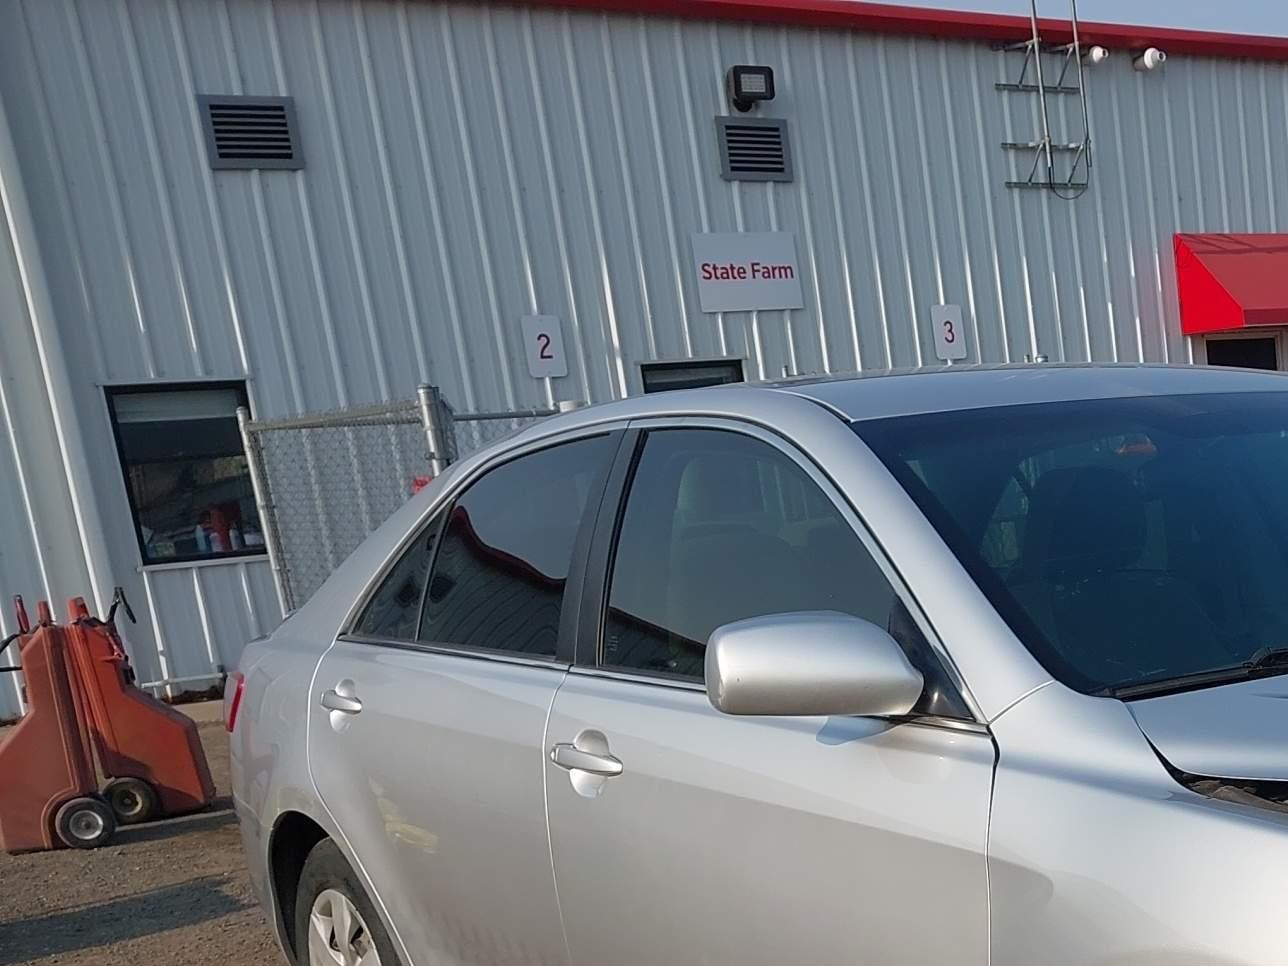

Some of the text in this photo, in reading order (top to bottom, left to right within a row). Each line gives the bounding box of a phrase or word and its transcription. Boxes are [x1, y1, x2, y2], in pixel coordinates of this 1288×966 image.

[701, 261, 794, 280] State Farm
[943, 320, 955, 344] 3
[536, 333, 553, 359] 2
